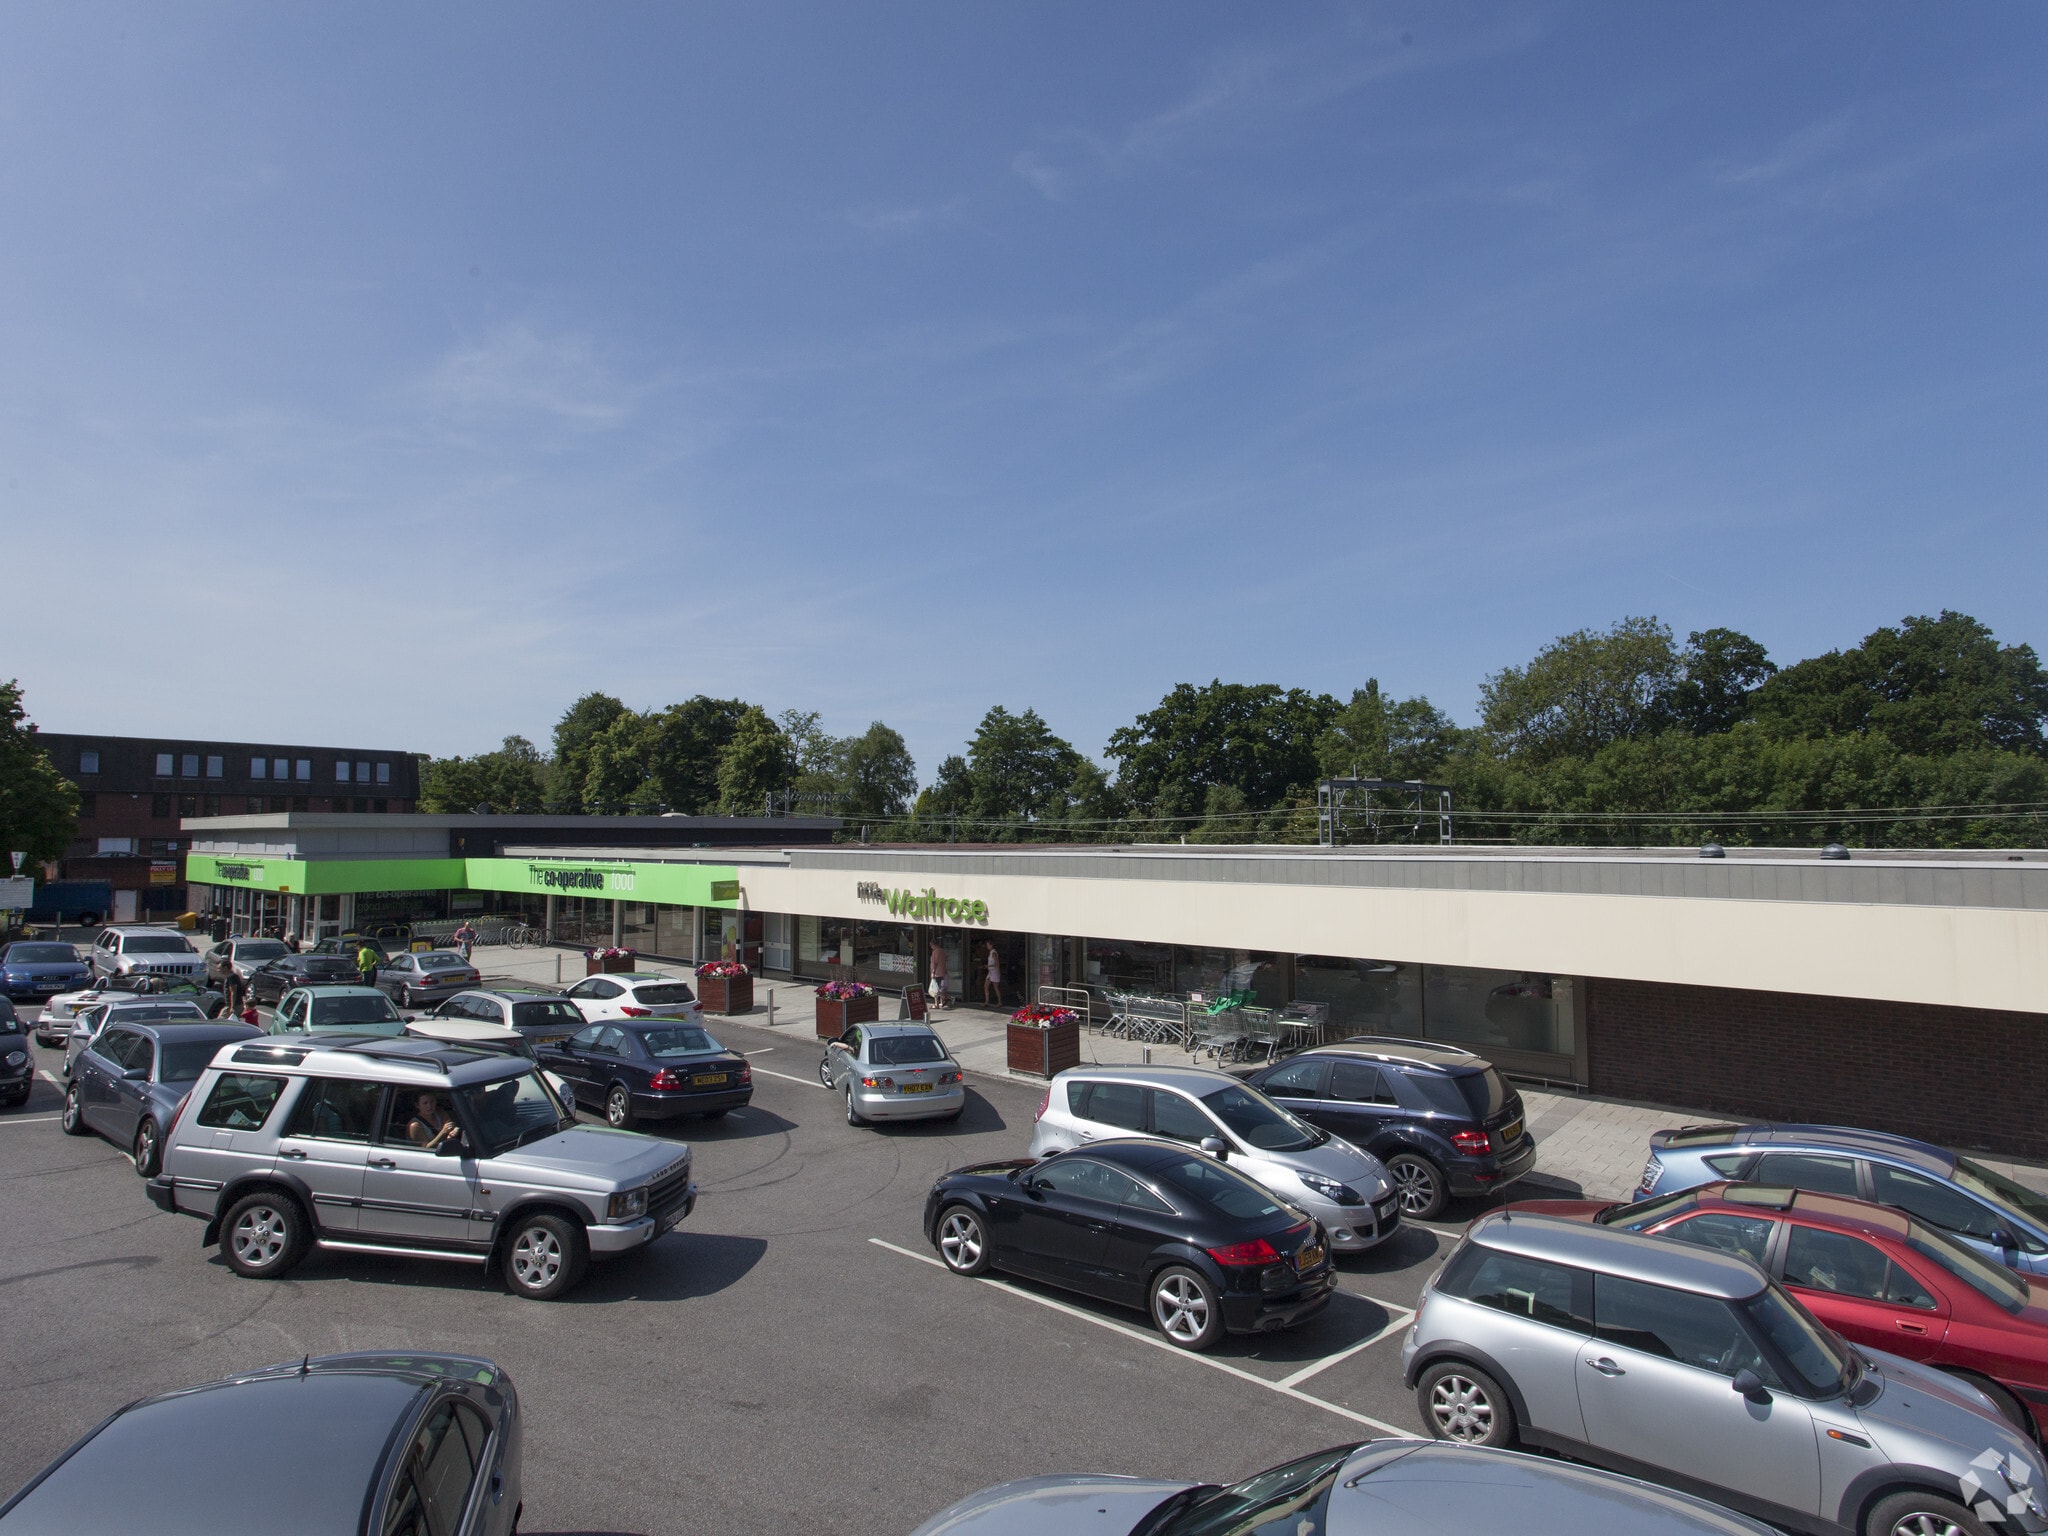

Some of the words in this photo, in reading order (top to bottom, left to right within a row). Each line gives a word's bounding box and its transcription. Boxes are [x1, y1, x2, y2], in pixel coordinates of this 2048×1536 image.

[529, 864, 543, 885] The
[544, 867, 604, 892] co-operative
[611, 867, 635, 891] food
[883, 886, 987, 921] Waitrose
[651, 1168, 668, 1180] LAND
[669, 1158, 685, 1171] ROVER
